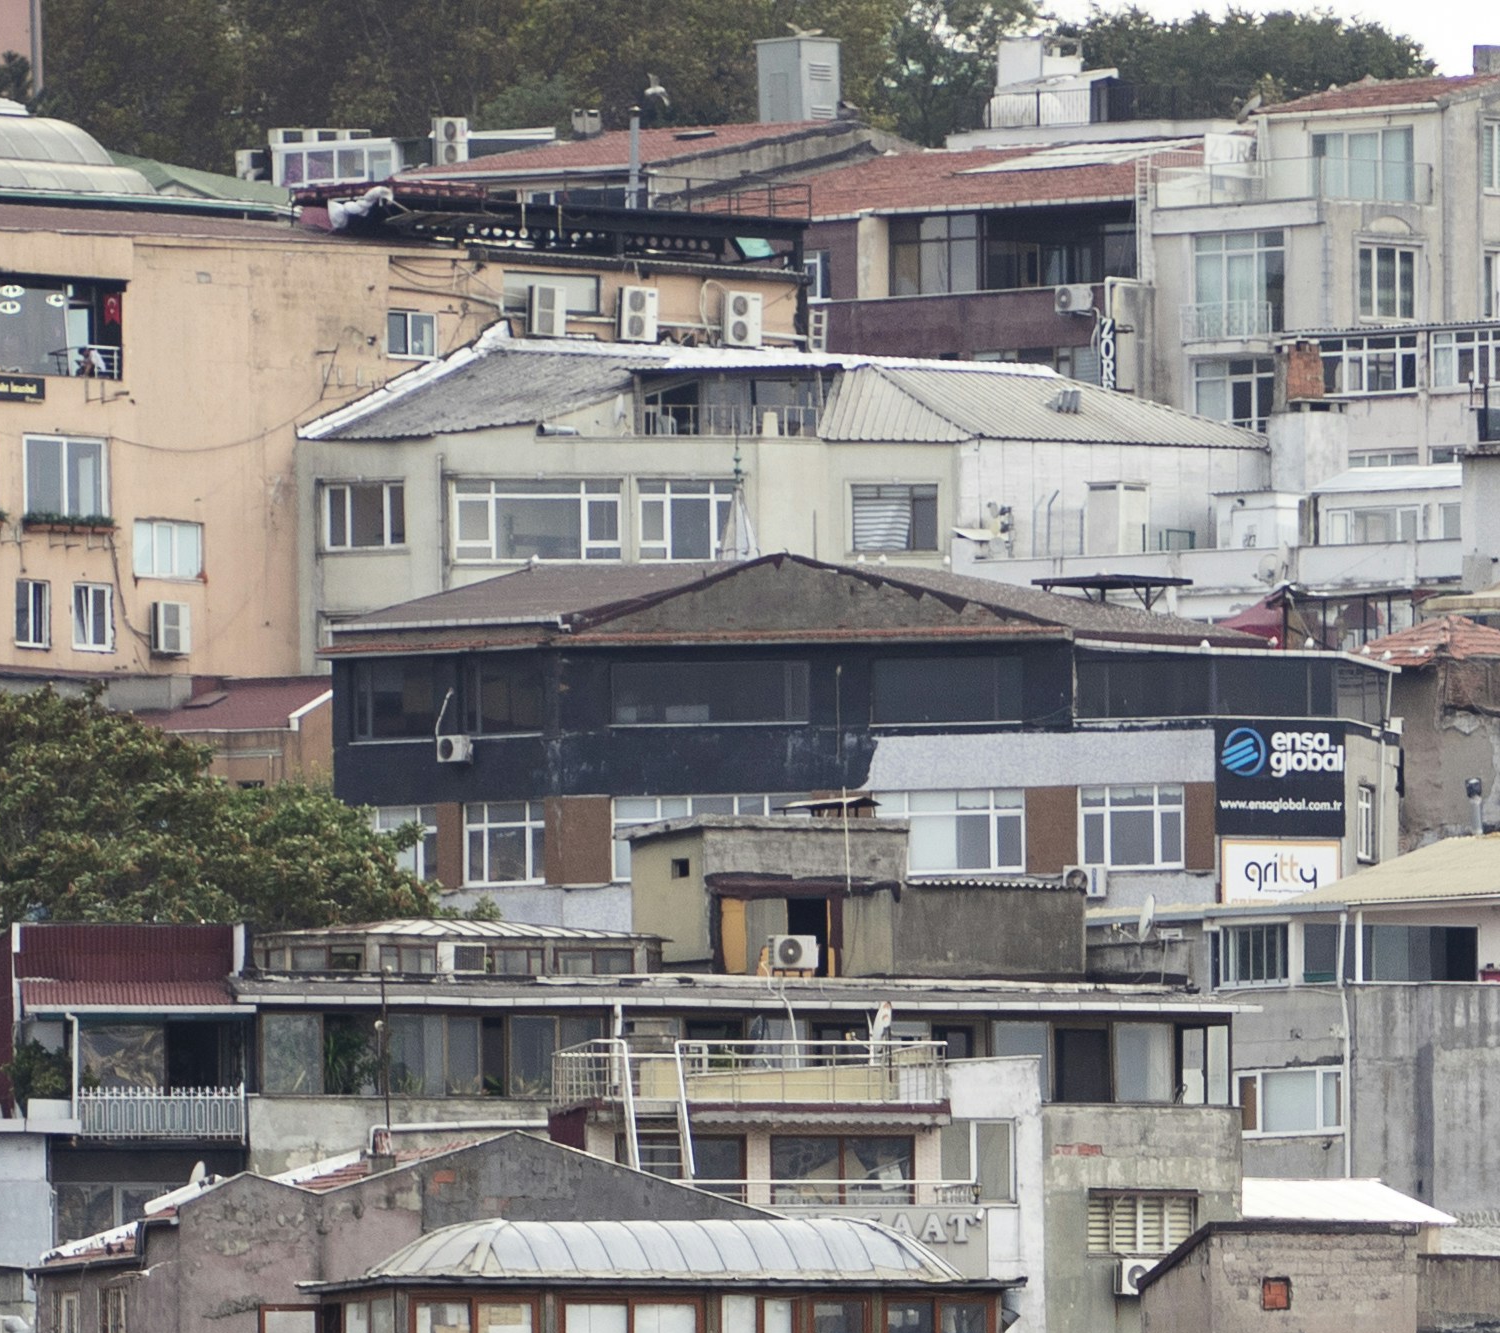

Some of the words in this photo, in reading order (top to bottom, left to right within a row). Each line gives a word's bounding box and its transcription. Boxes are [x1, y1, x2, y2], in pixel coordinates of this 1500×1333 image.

[1270, 745, 1344, 778] global
[1220, 798, 1342, 813] www.ensaglobal.com.tr
[1244, 853, 1318, 892] gritty
